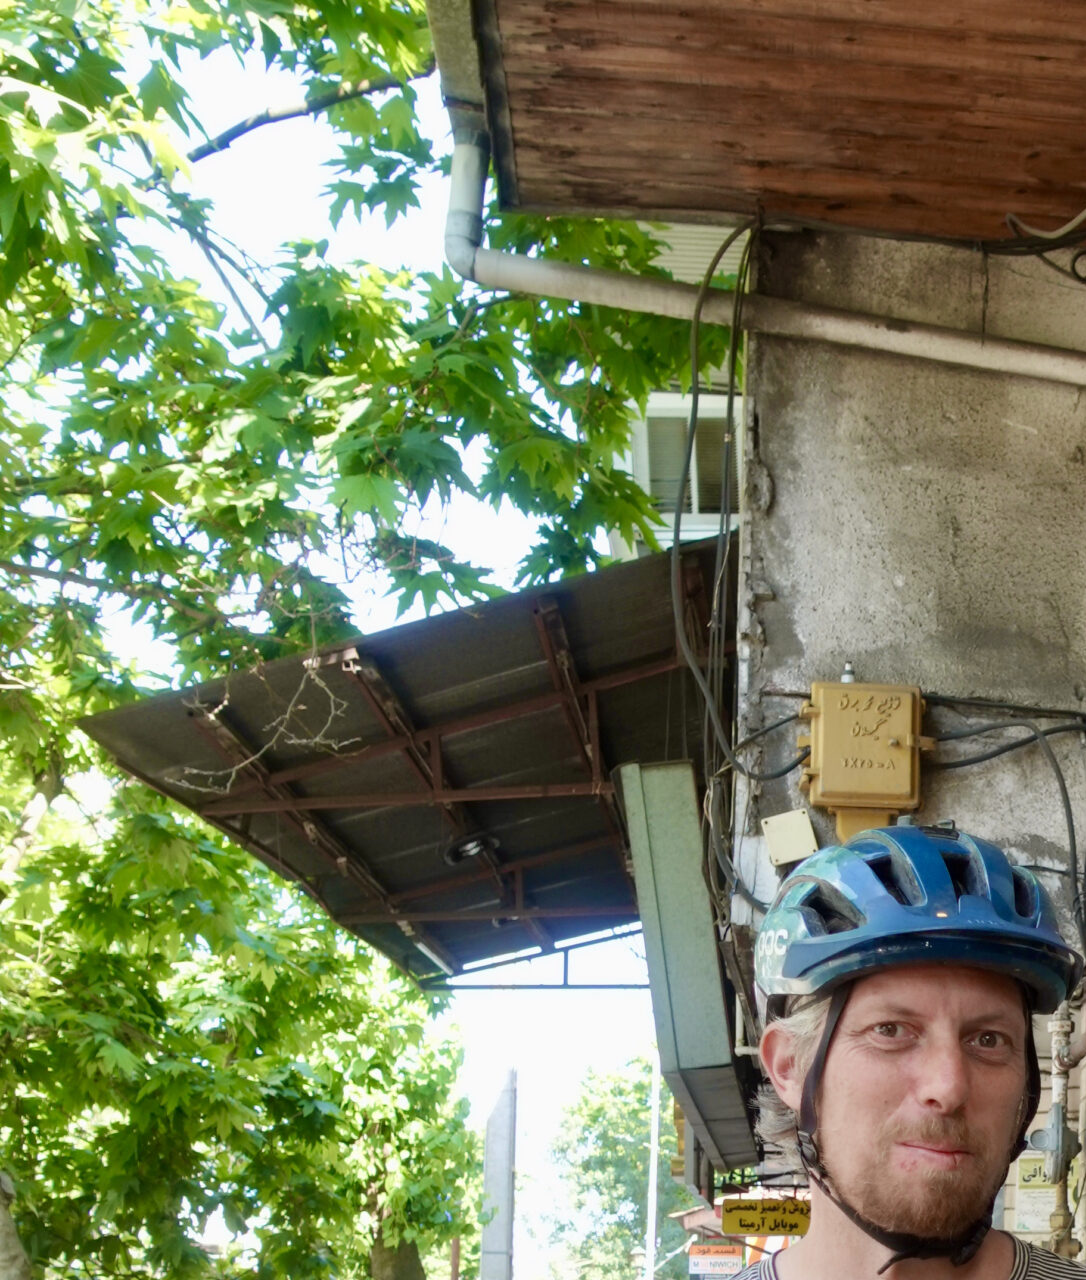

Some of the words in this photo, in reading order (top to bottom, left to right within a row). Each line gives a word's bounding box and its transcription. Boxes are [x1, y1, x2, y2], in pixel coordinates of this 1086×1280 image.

[725, 1202, 758, 1213] تخصصی
[739, 1216, 767, 1232] آرمیتا
[768, 1217, 799, 1232] موبایل
